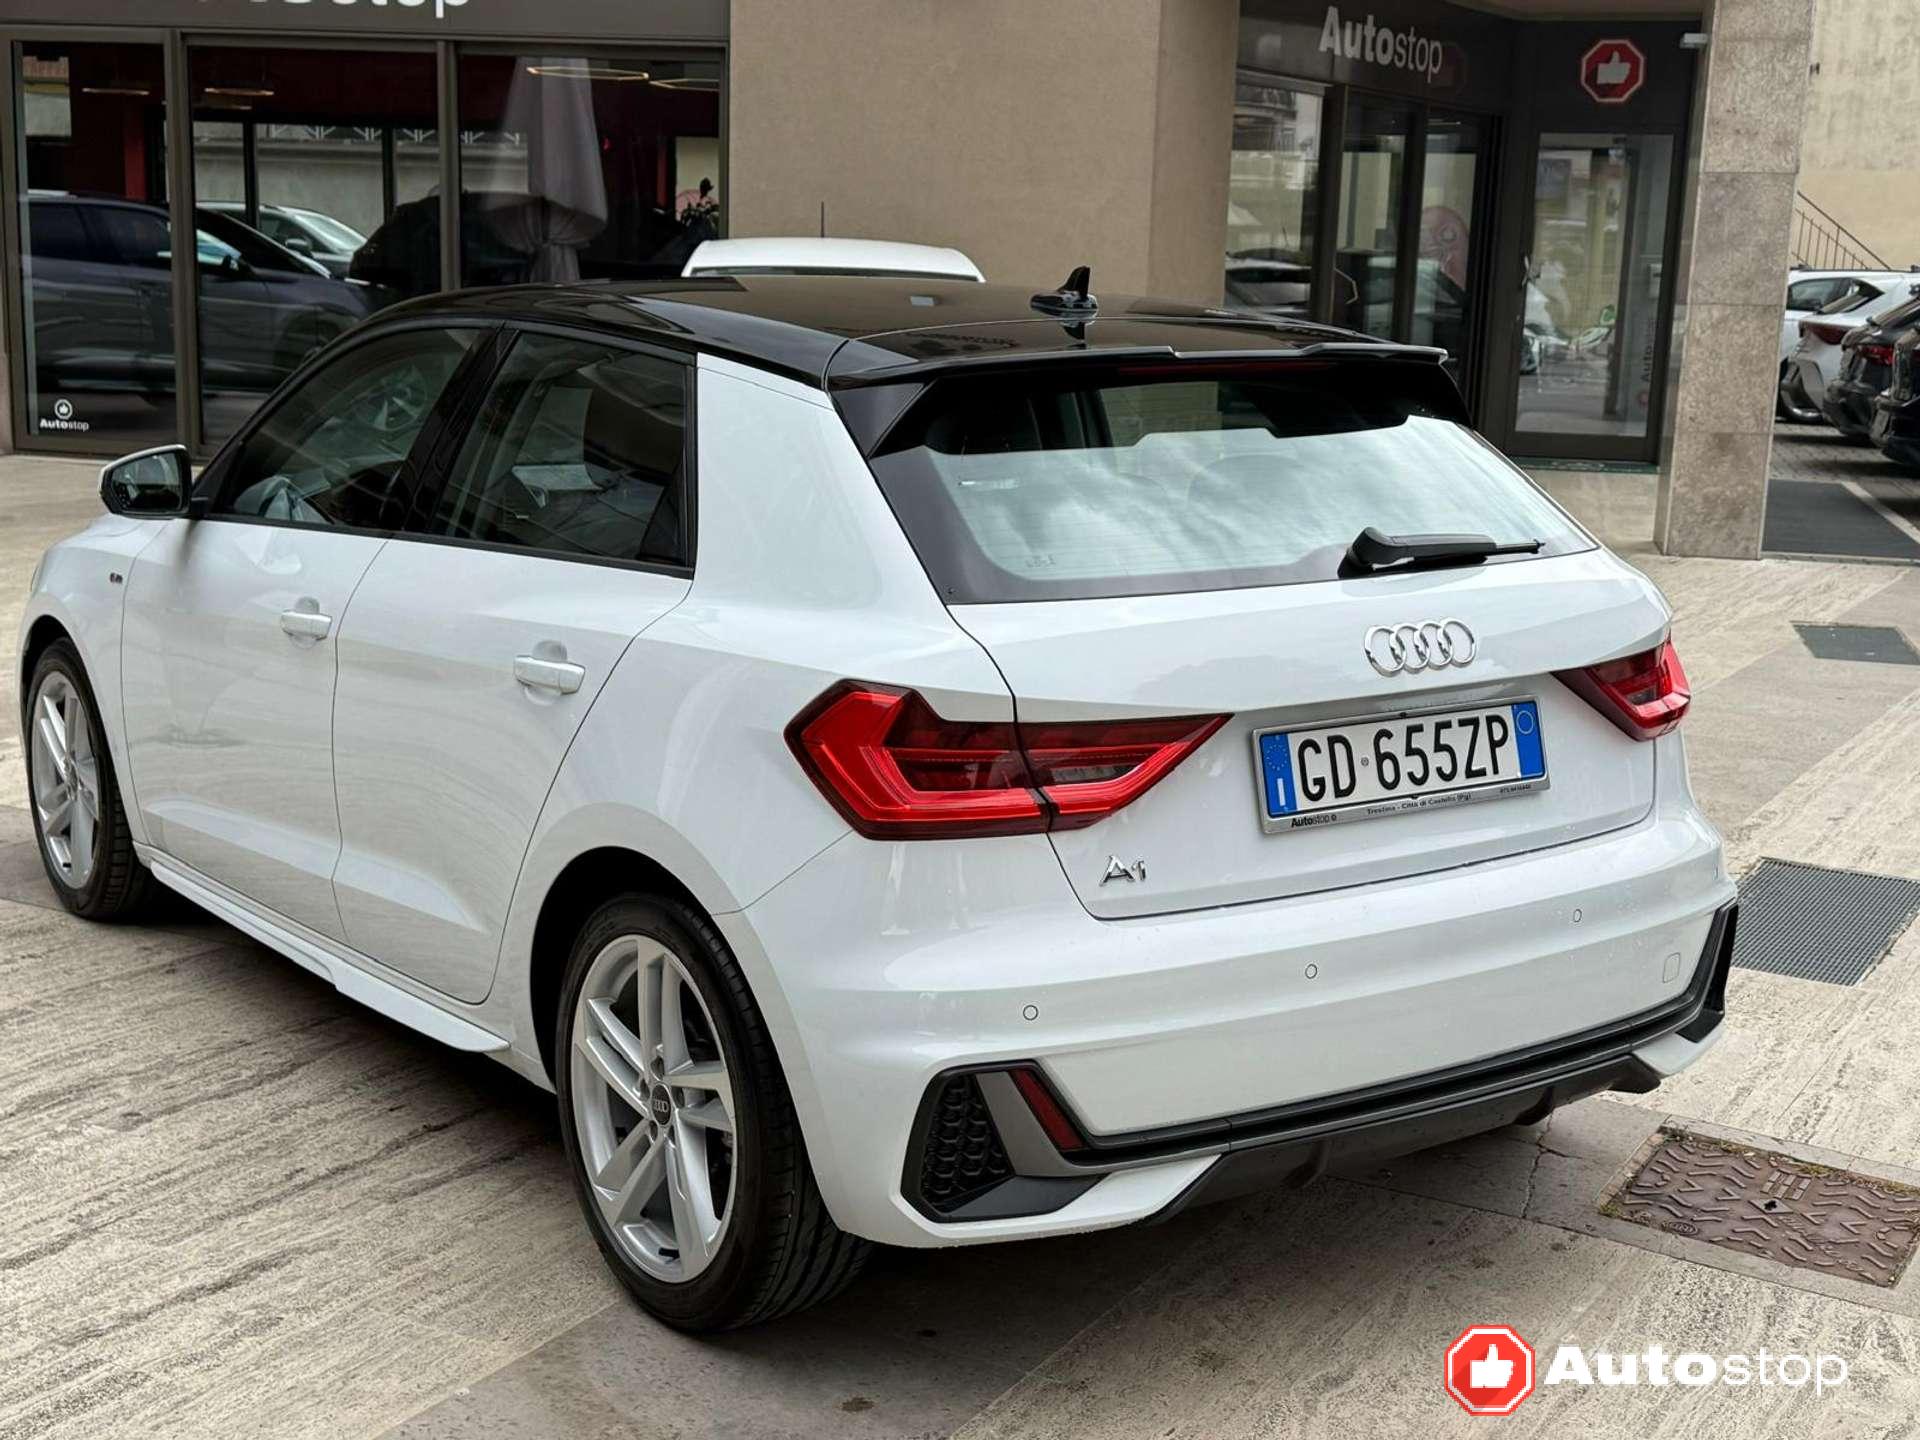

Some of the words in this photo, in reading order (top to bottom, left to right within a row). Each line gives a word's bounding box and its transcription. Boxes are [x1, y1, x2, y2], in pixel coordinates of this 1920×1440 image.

[1318, 5, 1443, 83] Autostop
[40, 418, 90, 432] Autostop
[1297, 734, 1357, 802] GD
[1372, 714, 1509, 791] 655ZP
[1290, 814, 1330, 828] Autostop
[1099, 855, 1147, 886] A1
